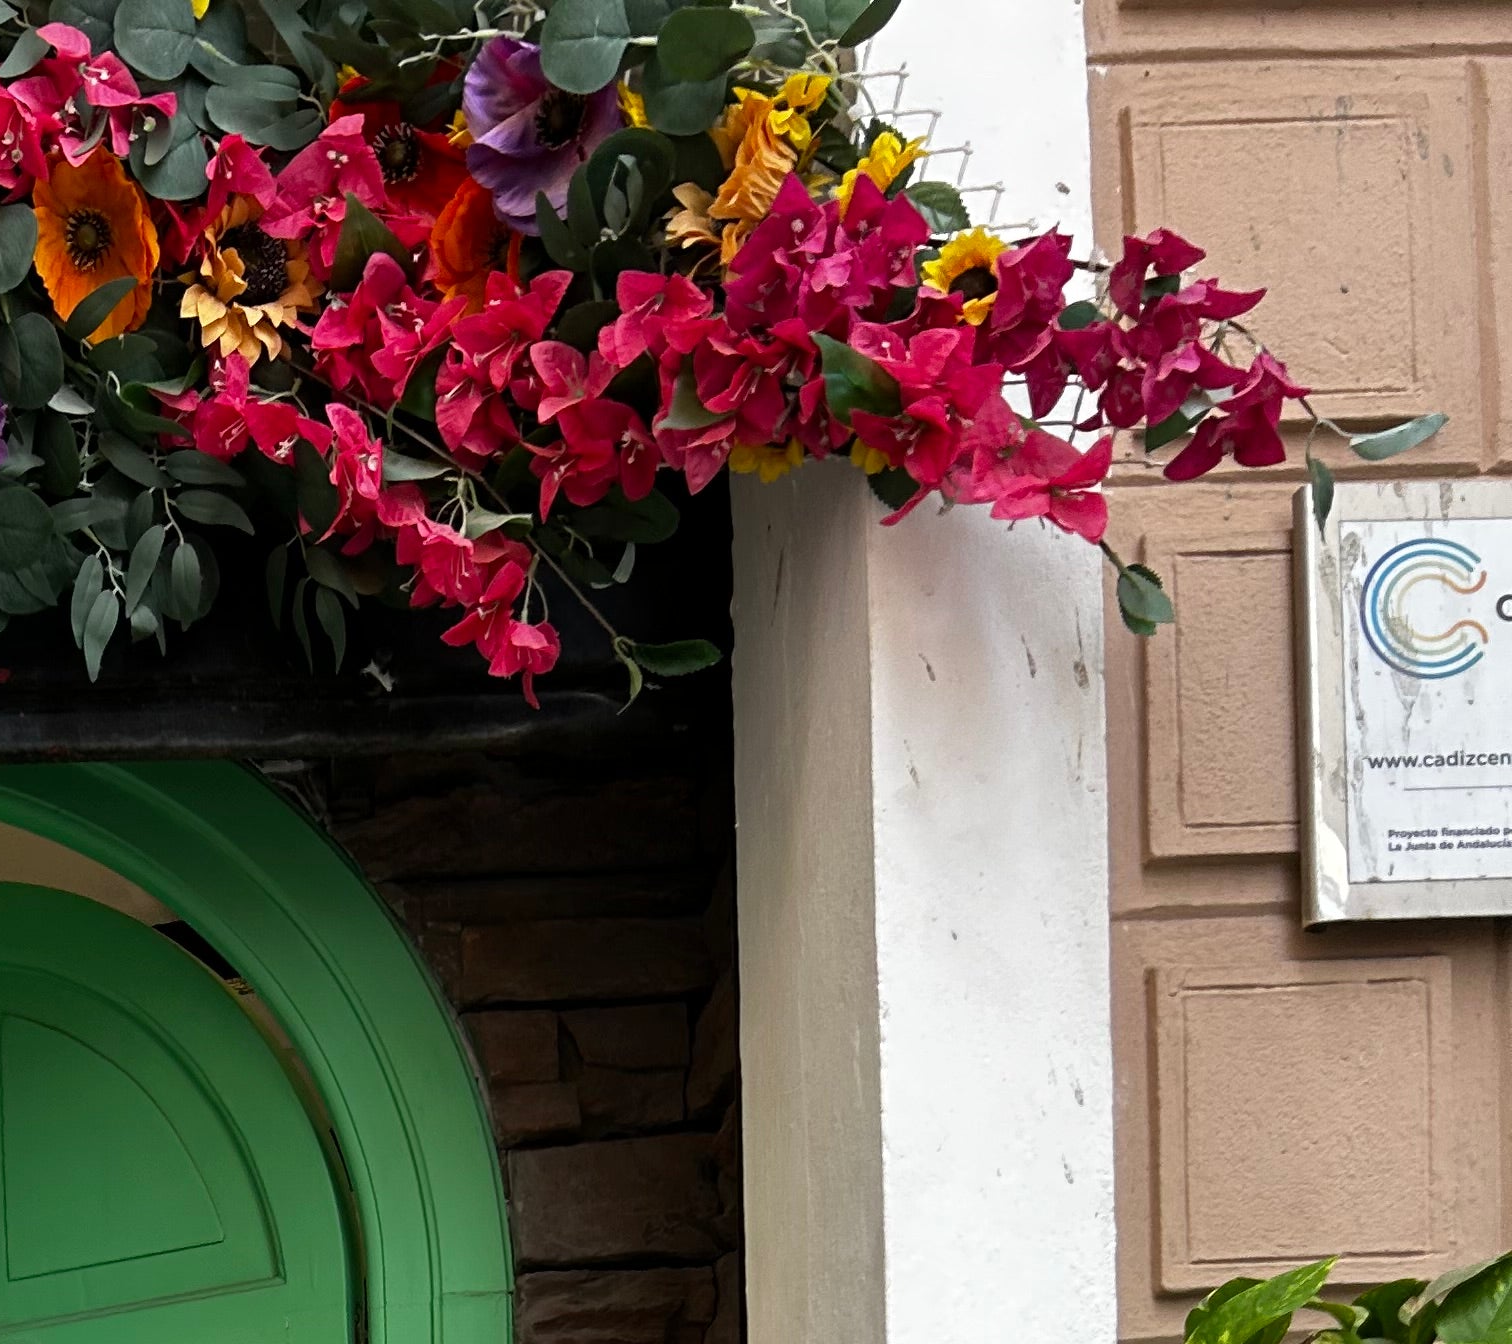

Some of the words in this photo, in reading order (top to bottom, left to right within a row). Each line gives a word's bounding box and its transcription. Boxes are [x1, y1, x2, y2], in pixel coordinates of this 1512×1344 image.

[1388, 829, 1438, 839] Proyecto
[1441, 826, 1501, 837] financiado
[1388, 842, 1402, 852] La
[1405, 841, 1436, 851] Junta
[1439, 840, 1454, 850] de
